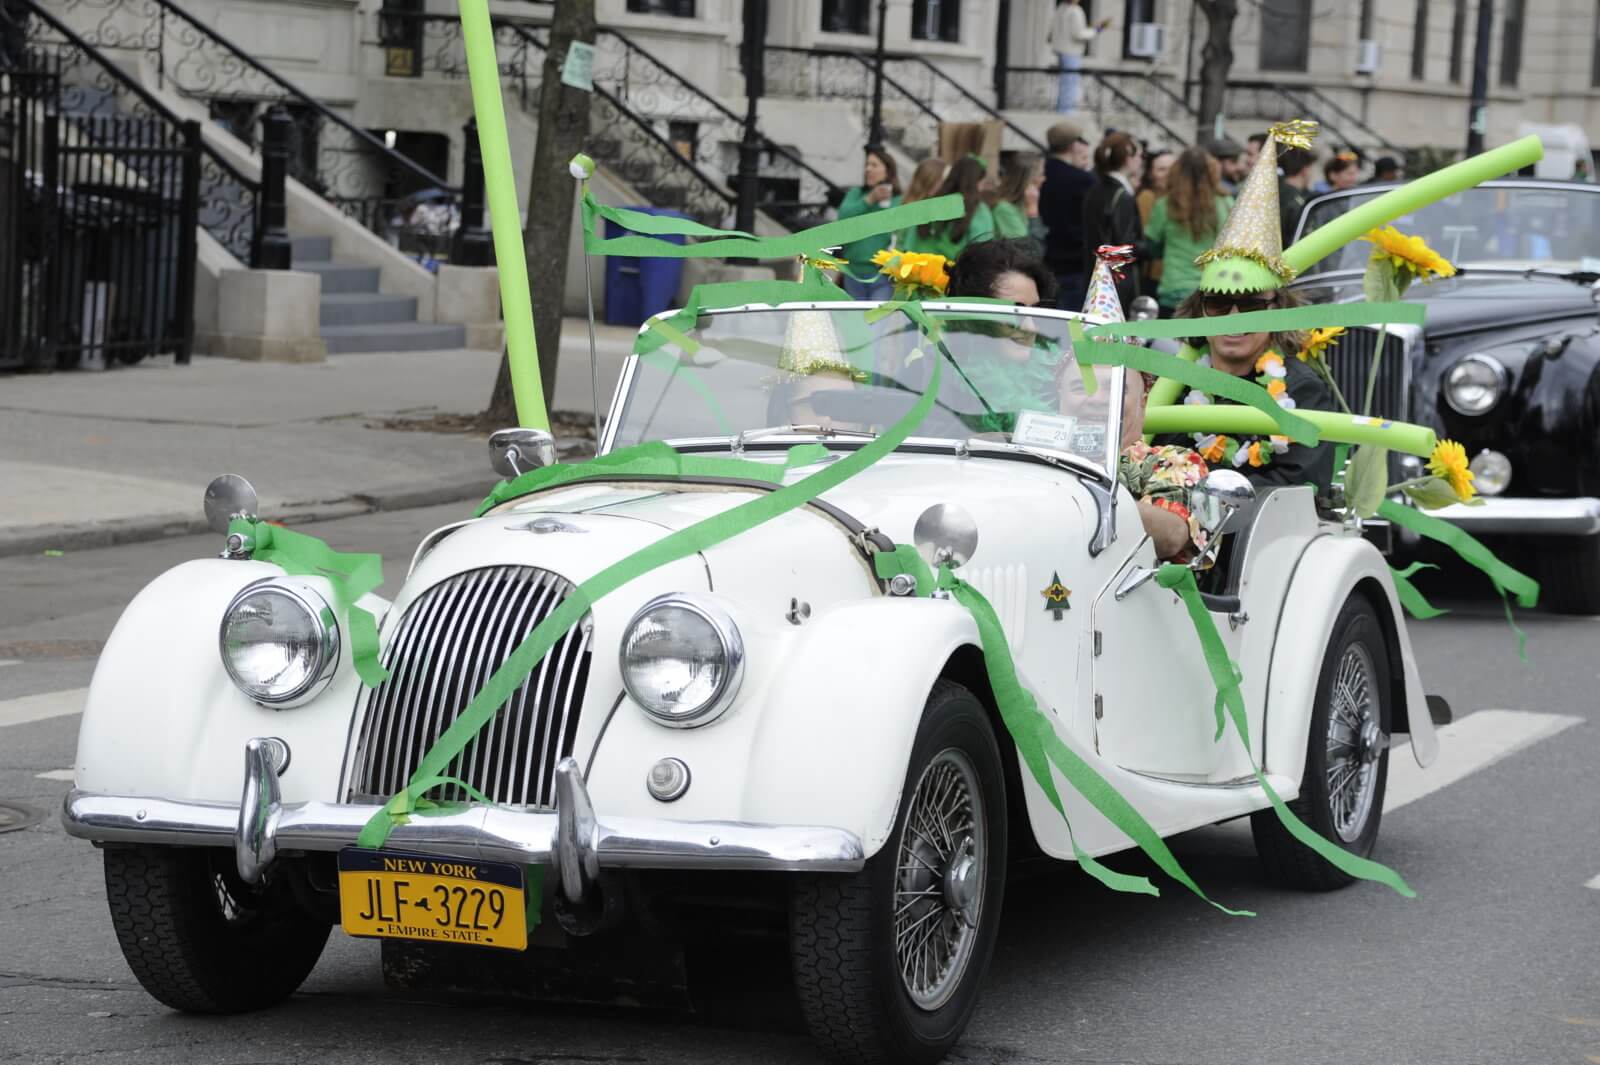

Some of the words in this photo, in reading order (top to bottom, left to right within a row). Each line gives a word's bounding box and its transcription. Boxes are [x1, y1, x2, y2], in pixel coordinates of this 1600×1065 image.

[384, 858, 426, 873] NEW
[431, 862, 477, 879] YORK
[360, 879, 410, 922] JLF
[433, 885, 505, 930] 3229
[388, 924, 438, 938] EMPIRE
[443, 930, 482, 942] STATE
